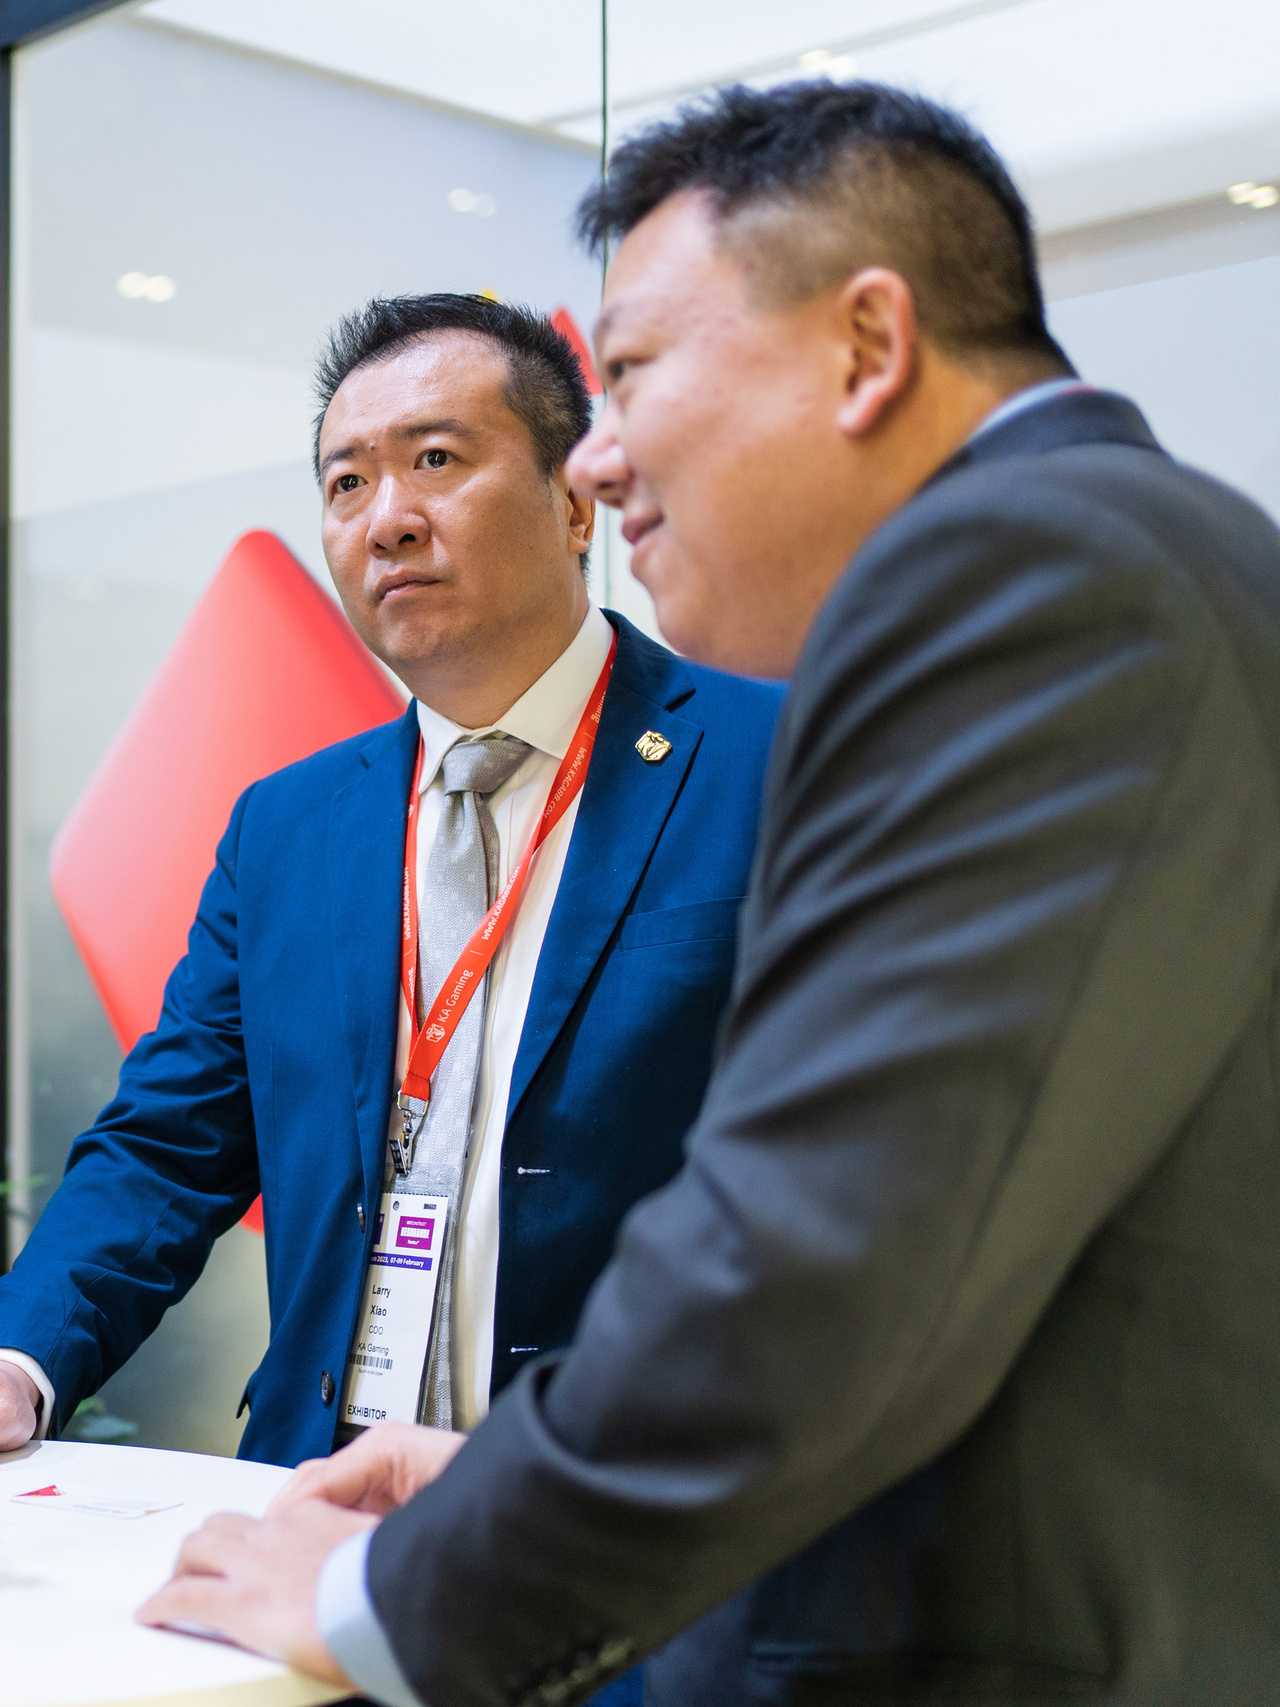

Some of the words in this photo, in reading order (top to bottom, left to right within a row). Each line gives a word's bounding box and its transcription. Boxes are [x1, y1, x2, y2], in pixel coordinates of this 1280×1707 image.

[437, 1008, 452, 1023] KA
[446, 969, 474, 1007] Gaming
[403, 1258, 424, 1268] February
[372, 1284, 391, 1298] Larry
[370, 1305, 387, 1317] Xiao
[368, 1325, 384, 1336] COO
[367, 1343, 389, 1356] Gaming
[347, 1404, 387, 1421] EXHIBITOR
